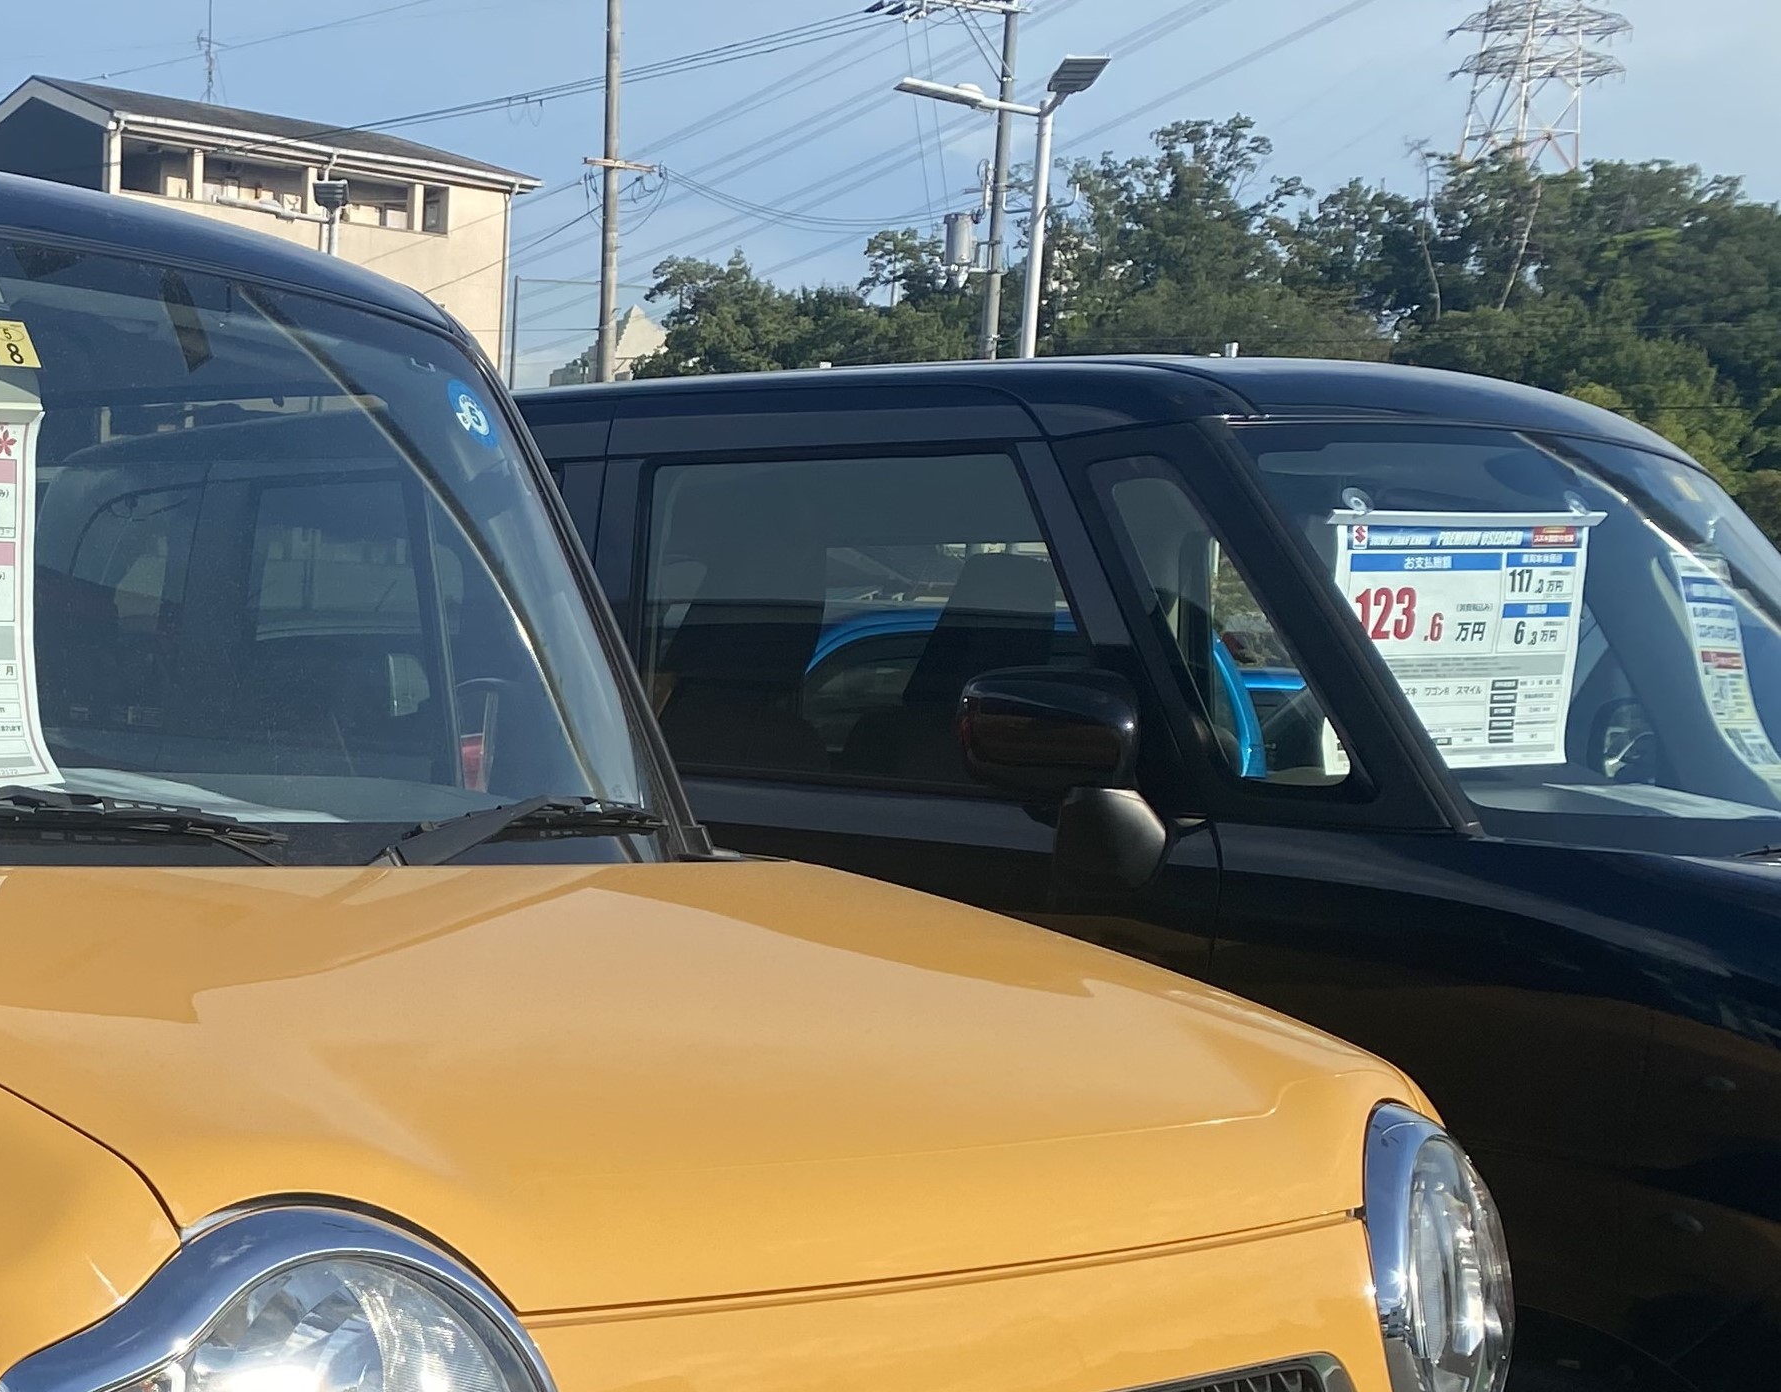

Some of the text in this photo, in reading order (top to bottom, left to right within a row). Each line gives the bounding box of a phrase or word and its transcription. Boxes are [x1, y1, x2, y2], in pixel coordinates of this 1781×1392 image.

[2, 328, 12, 340] 5
[6, 343, 24, 364] 8
[468, 406, 482, 426] 5
[1509, 569, 1533, 593] 117
[1455, 621, 1487, 642] 万円
[1513, 620, 1526, 645] 6
[6, 666, 14, 676] 月
[1456, 685, 1481, 696] スマイル
